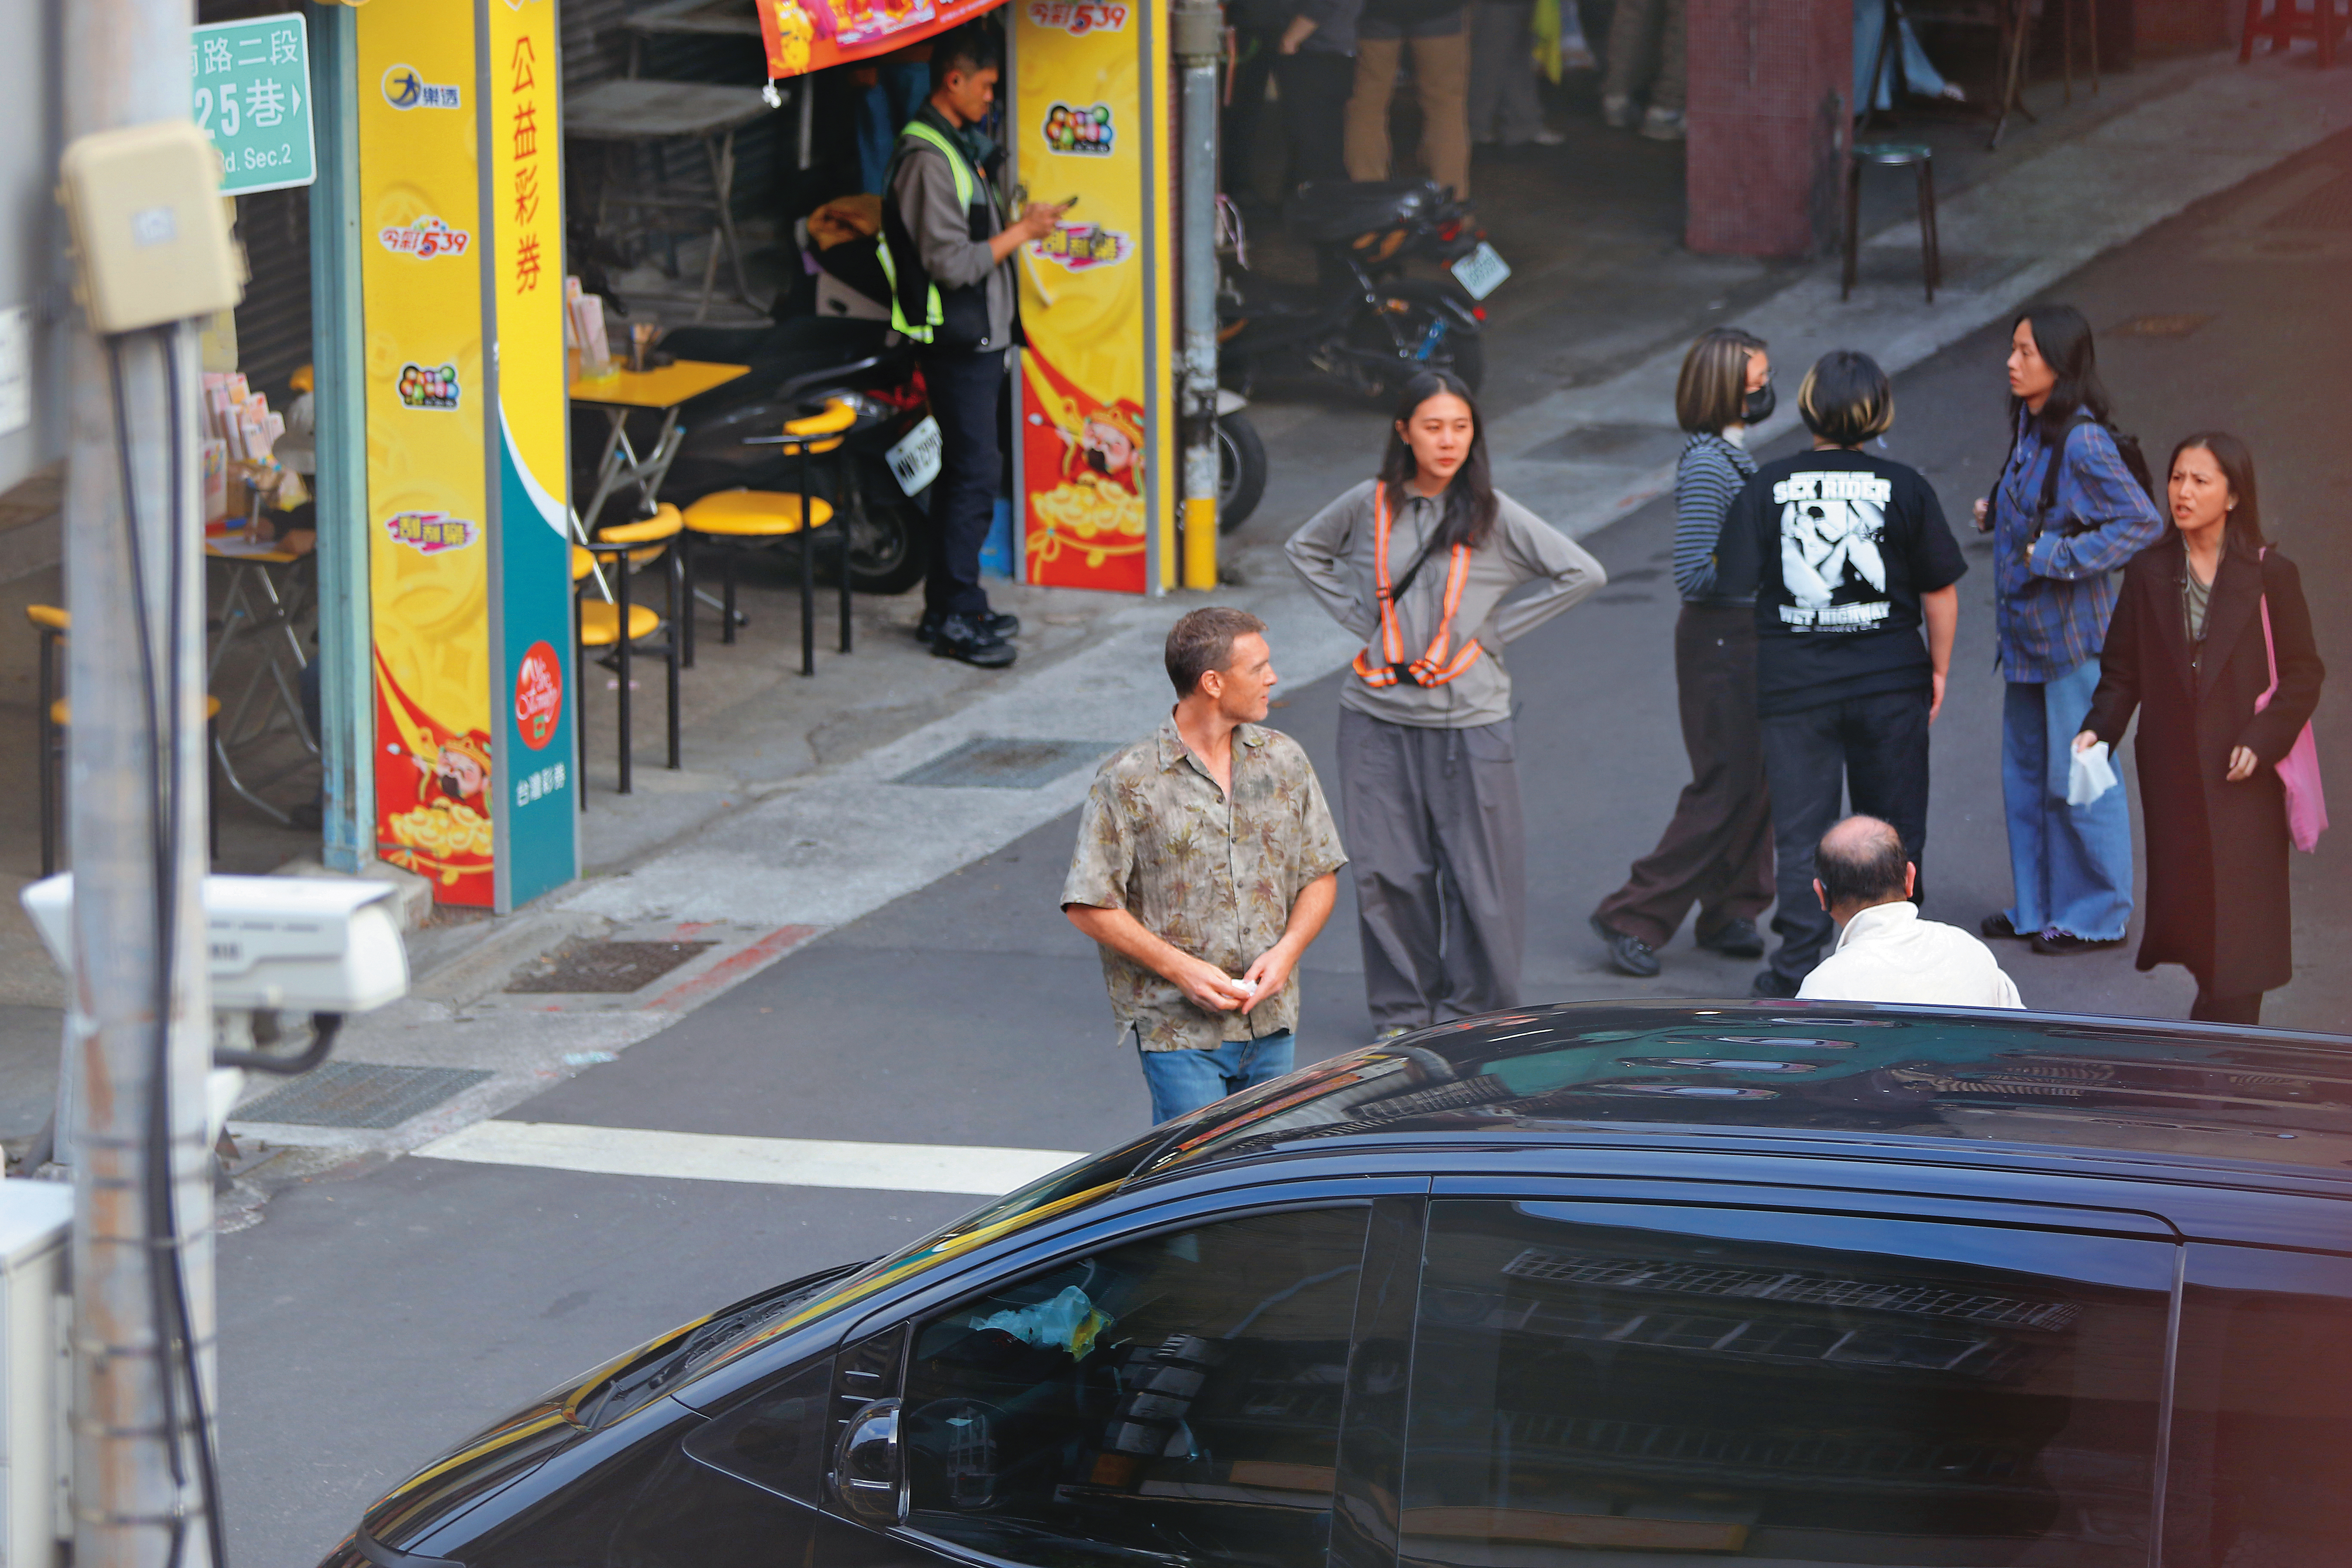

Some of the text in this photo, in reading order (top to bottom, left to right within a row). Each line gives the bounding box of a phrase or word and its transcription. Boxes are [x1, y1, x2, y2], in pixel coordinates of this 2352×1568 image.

[191, 30, 298, 77] 路二段
[511, 35, 541, 295] 公益彩券
[383, 230, 467, 257] 今彩539
[1773, 478, 1892, 505] SEX RIDER
